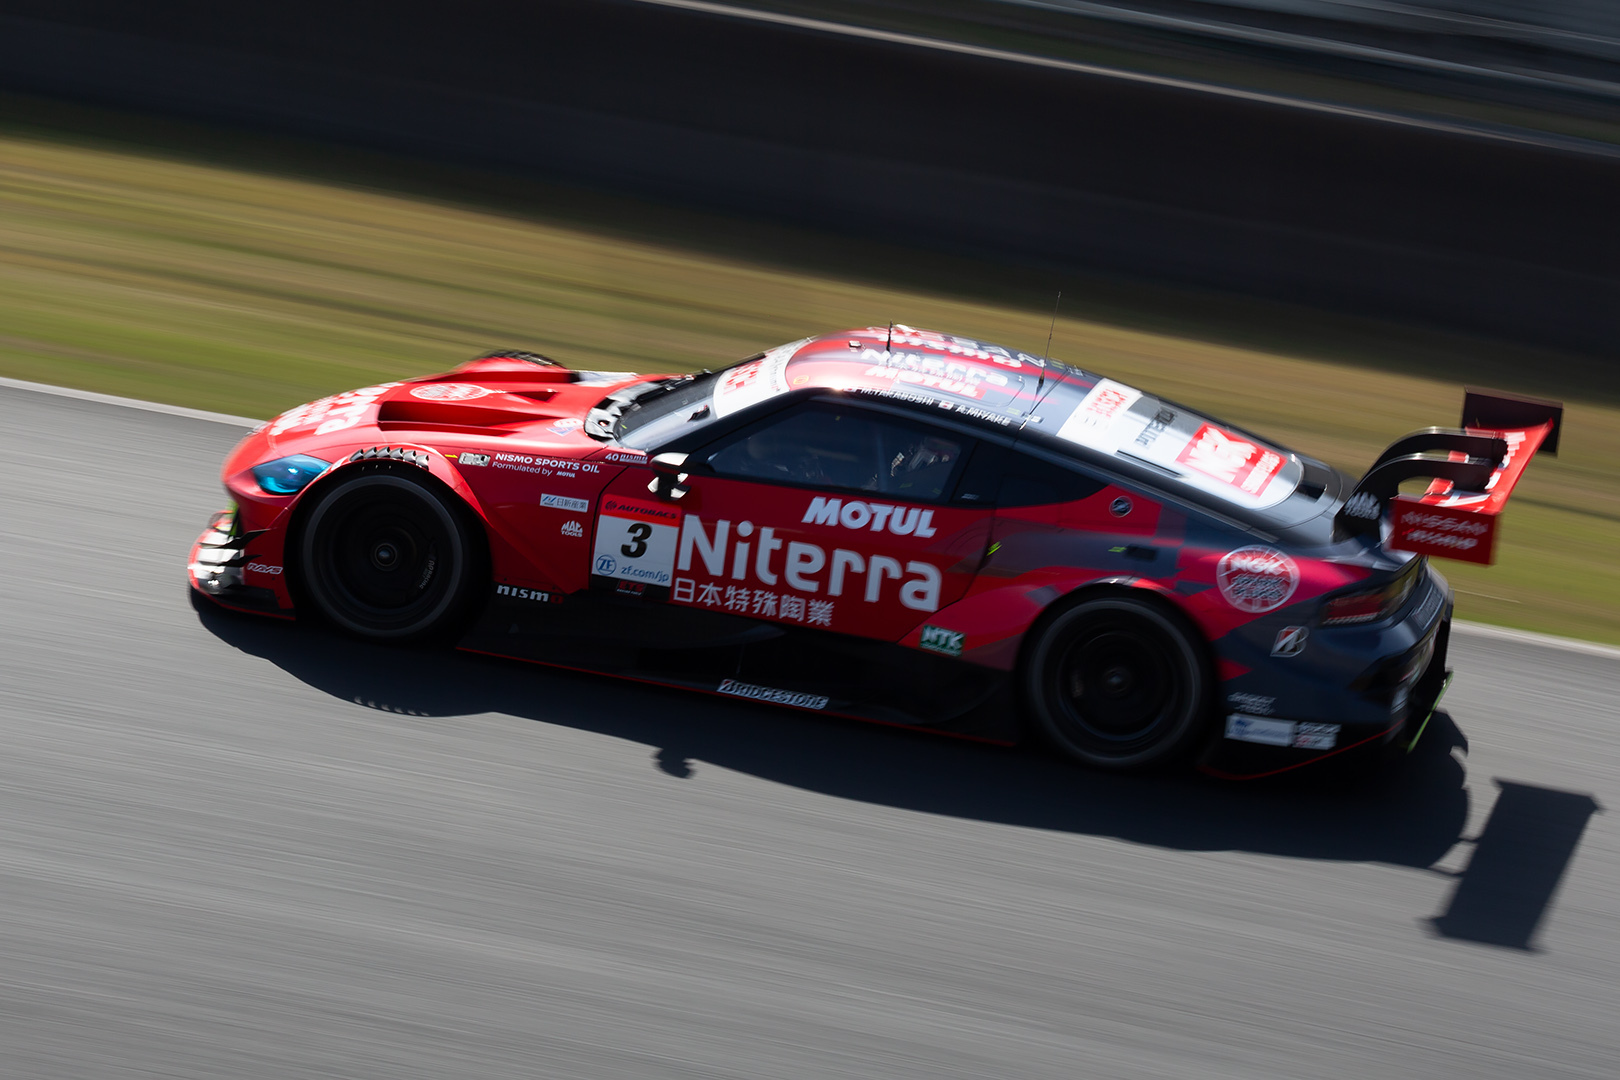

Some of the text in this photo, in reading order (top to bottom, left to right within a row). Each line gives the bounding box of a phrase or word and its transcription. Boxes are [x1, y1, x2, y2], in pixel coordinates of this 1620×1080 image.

[495, 452, 601, 474] NISMO SPORTS OIL
[604, 452, 620, 462] 40
[492, 460, 576, 479] Formulated by MOTUL
[617, 503, 678, 520] AUTOBACS
[801, 495, 937, 539] MOTUL
[560, 520, 583, 532] MAC
[620, 522, 653, 559] 3
[598, 557, 614, 574] ZF
[620, 564, 670, 584] zf.com/jp
[676, 513, 943, 614] Niterra
[1230, 555, 1288, 577] NGK
[496, 584, 563, 605] nismo
[673, 577, 835, 627] 日本特殊陶業
[921, 625, 967, 652] NTK
[716, 678, 829, 710] BRIDGESTONE
